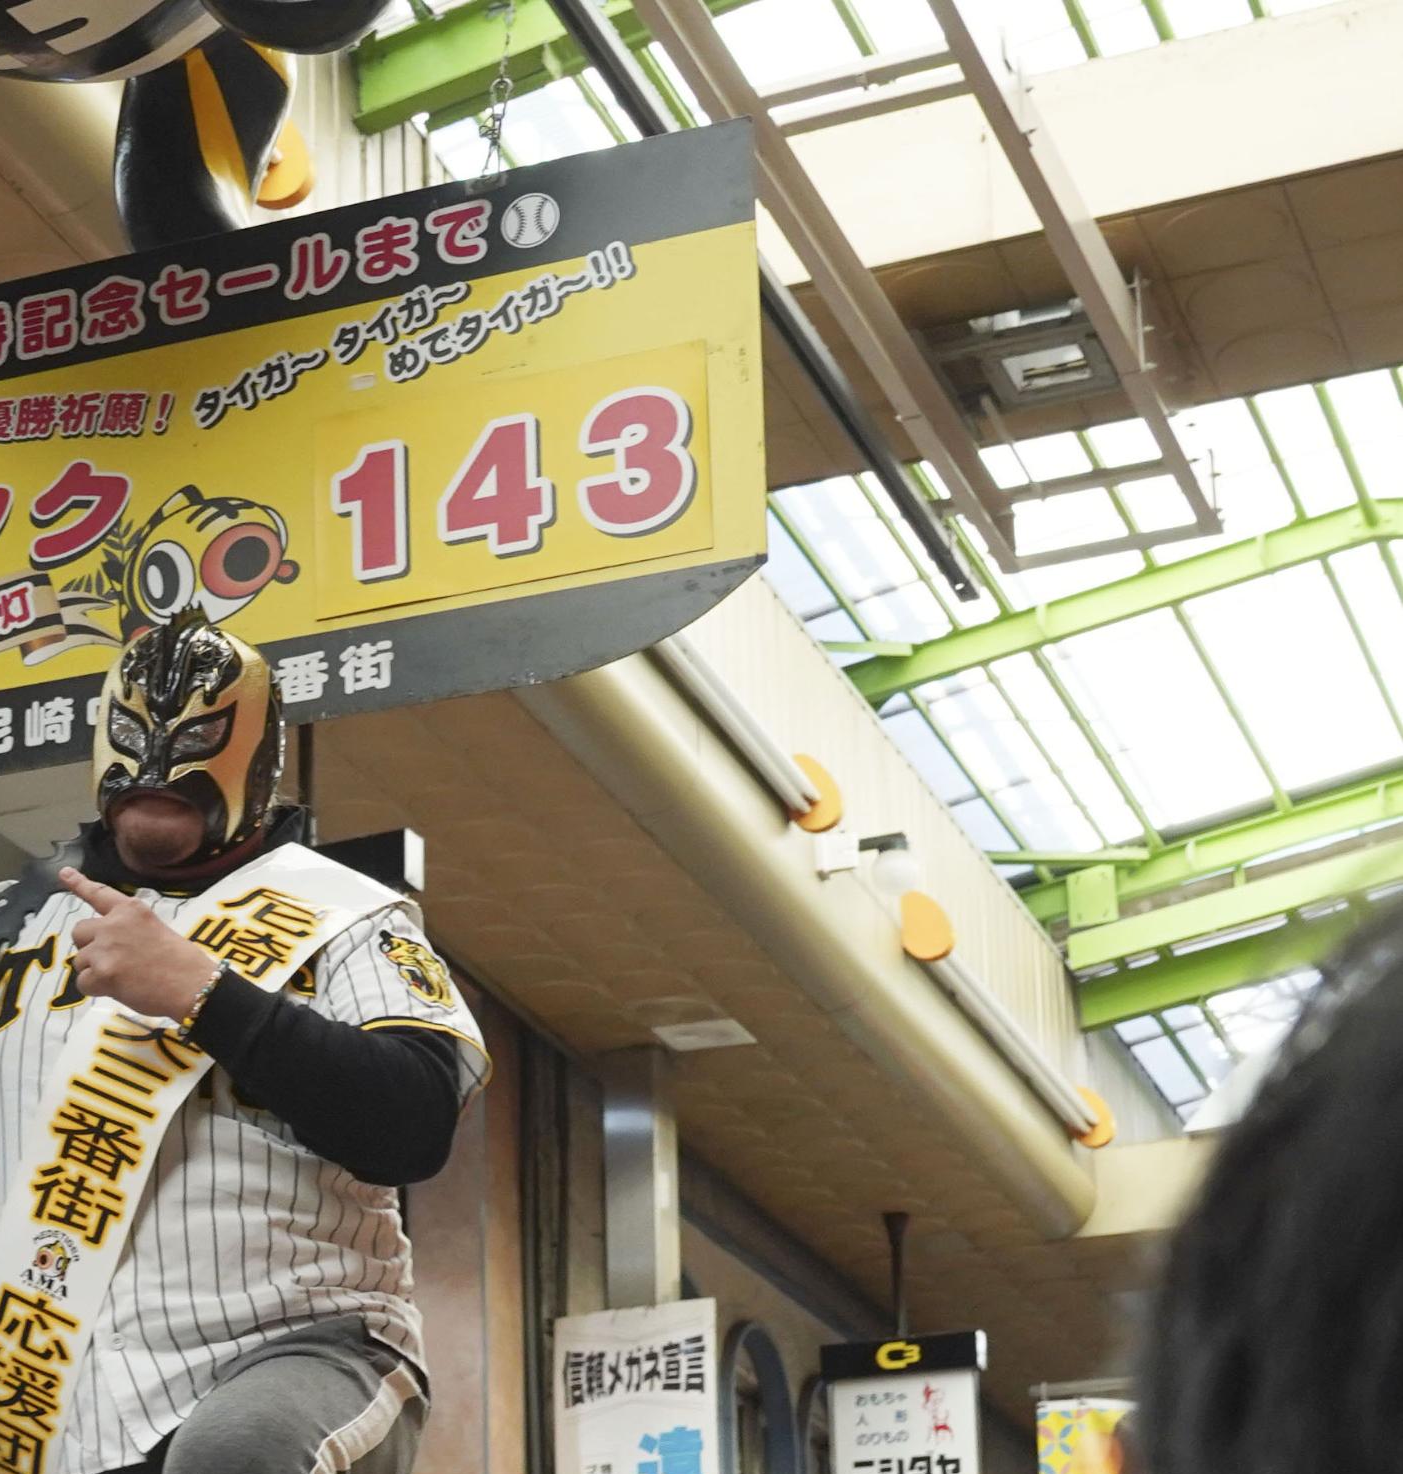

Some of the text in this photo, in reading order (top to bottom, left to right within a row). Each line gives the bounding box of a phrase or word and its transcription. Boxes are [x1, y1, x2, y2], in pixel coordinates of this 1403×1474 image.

[331, 385, 695, 582] 143
[563, 1335, 706, 1408] 信頼メガネ宣言
